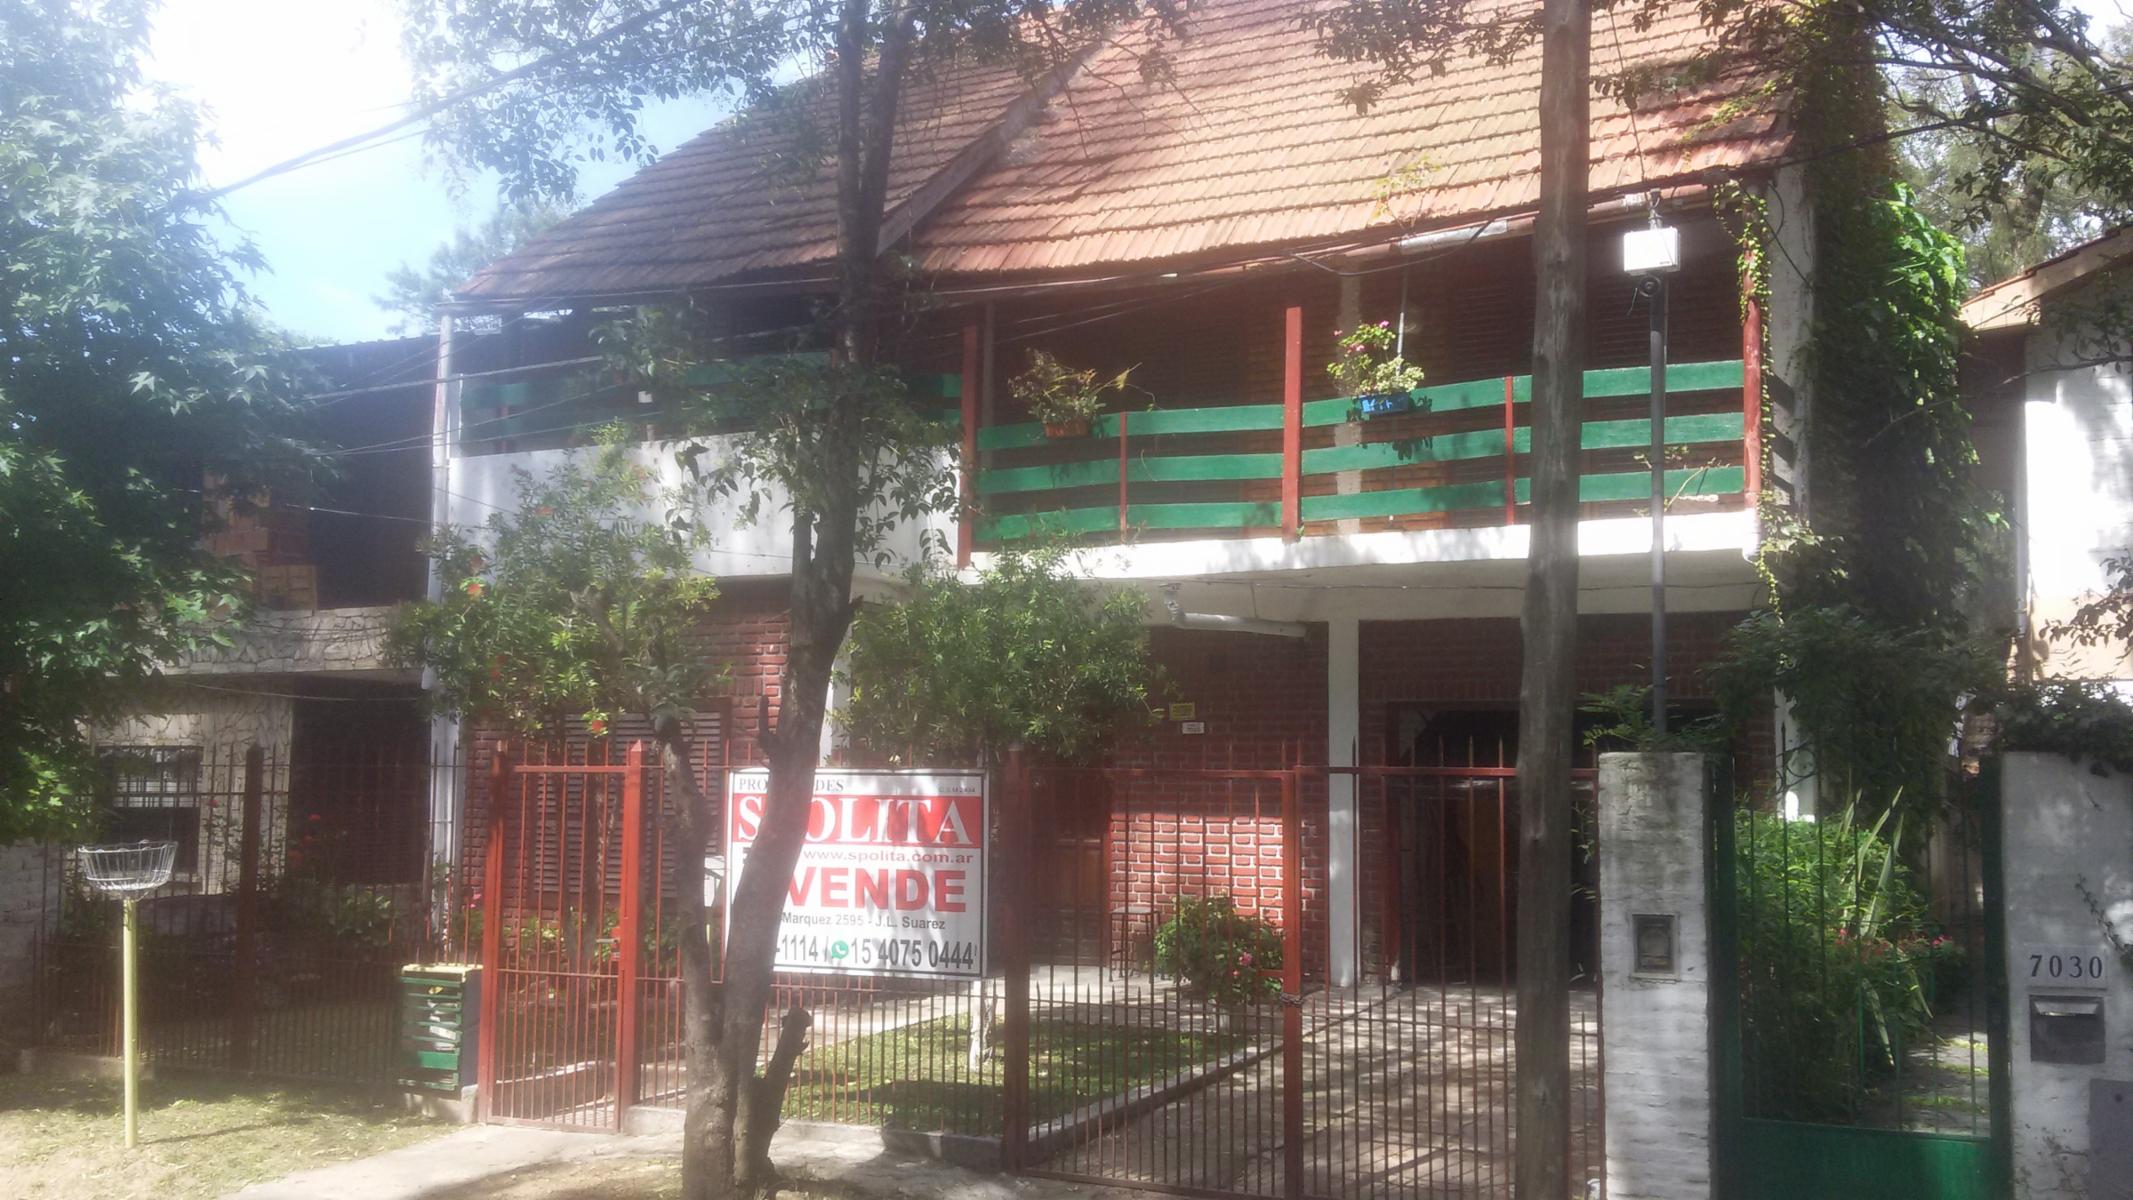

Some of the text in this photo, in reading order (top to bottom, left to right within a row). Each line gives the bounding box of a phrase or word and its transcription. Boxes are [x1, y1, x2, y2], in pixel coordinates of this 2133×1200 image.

[738, 796, 973, 845] SOLITA
[803, 850, 974, 864] www.spolita.com.ar
[787, 866, 966, 913] VENDE
[781, 911, 832, 926] Marquez
[835, 913, 864, 926] 2595
[875, 914, 898, 928] J.L.
[902, 916, 946, 930] Suarez
[851, 937, 871, 964] 15
[878, 938, 922, 967] 4075
[928, 940, 974, 970] 0444
[2029, 954, 2103, 979] 7030
